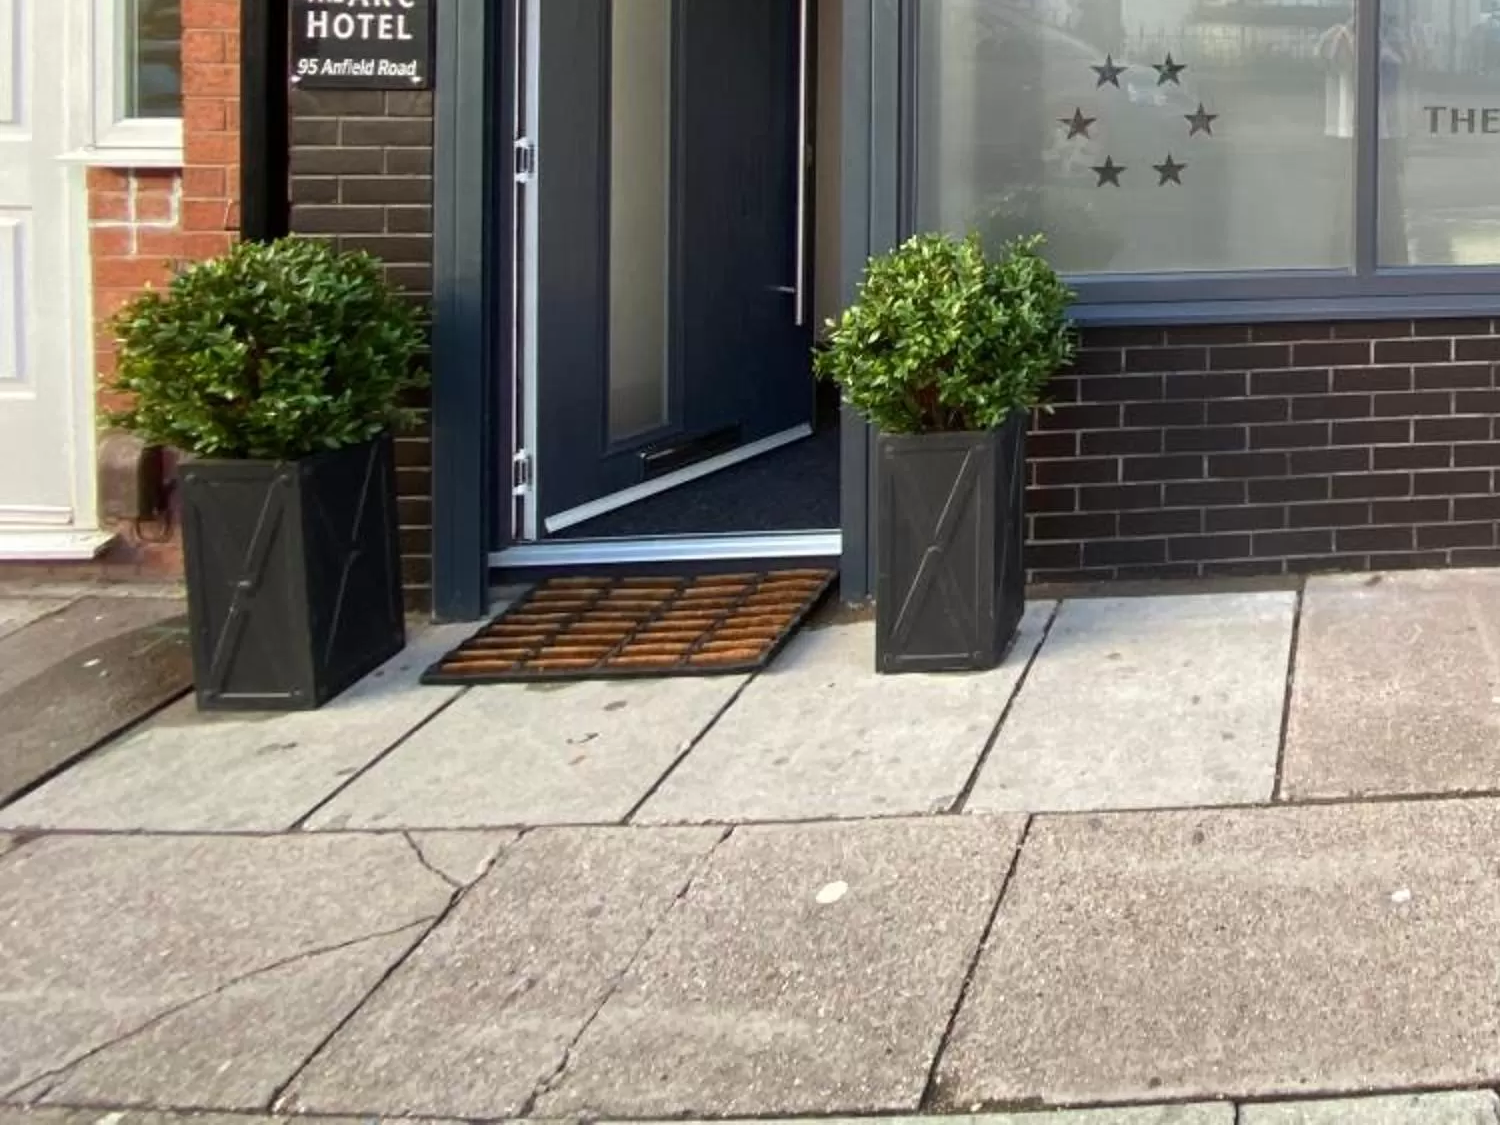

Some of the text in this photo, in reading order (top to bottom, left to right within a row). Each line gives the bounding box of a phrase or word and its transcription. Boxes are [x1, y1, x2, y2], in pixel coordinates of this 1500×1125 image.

[306, 10, 414, 41] HOTEL
[297, 58, 417, 76] 95 Anfield Road
